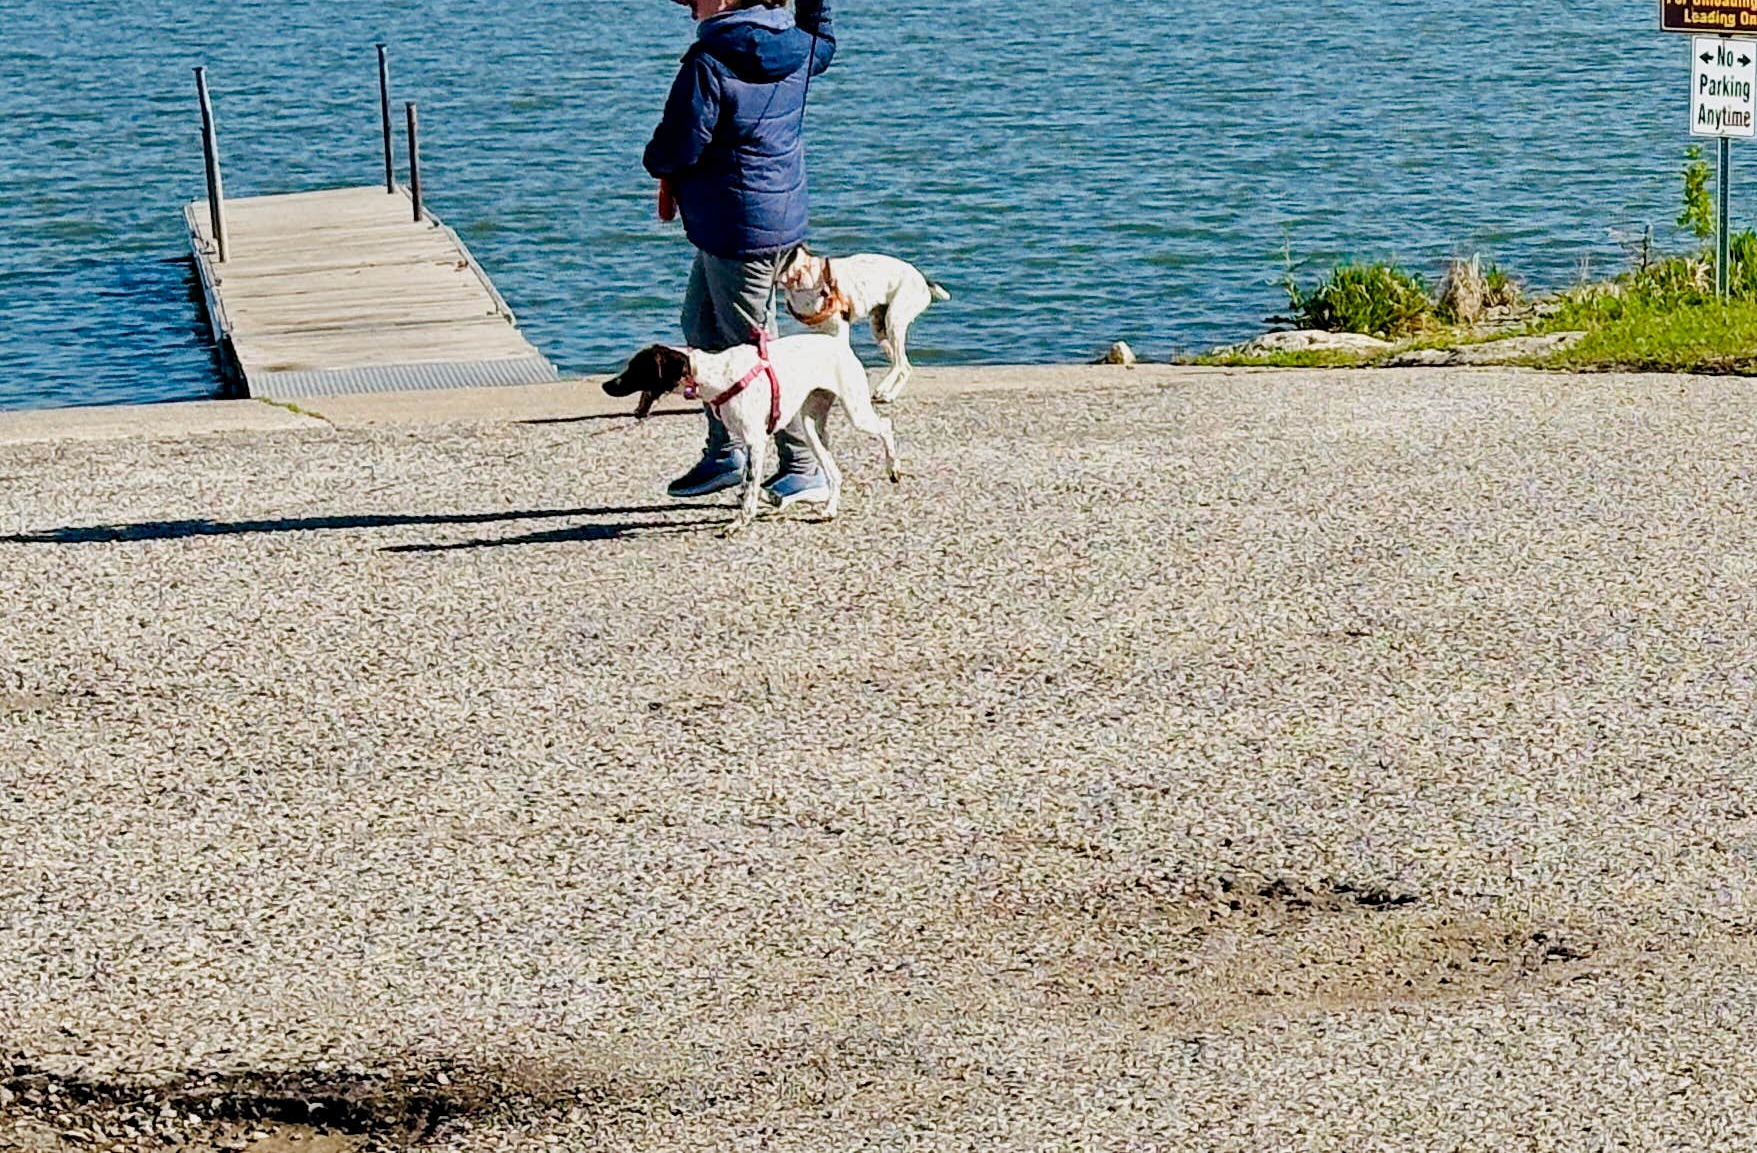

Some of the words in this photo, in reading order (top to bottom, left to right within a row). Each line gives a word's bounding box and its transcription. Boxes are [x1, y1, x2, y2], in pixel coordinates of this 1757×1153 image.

[1684, 8, 1736, 28] Loading
[1717, 45, 1734, 67] No
[1700, 74, 1750, 102] Parking
[1698, 103, 1751, 130] Anytime
